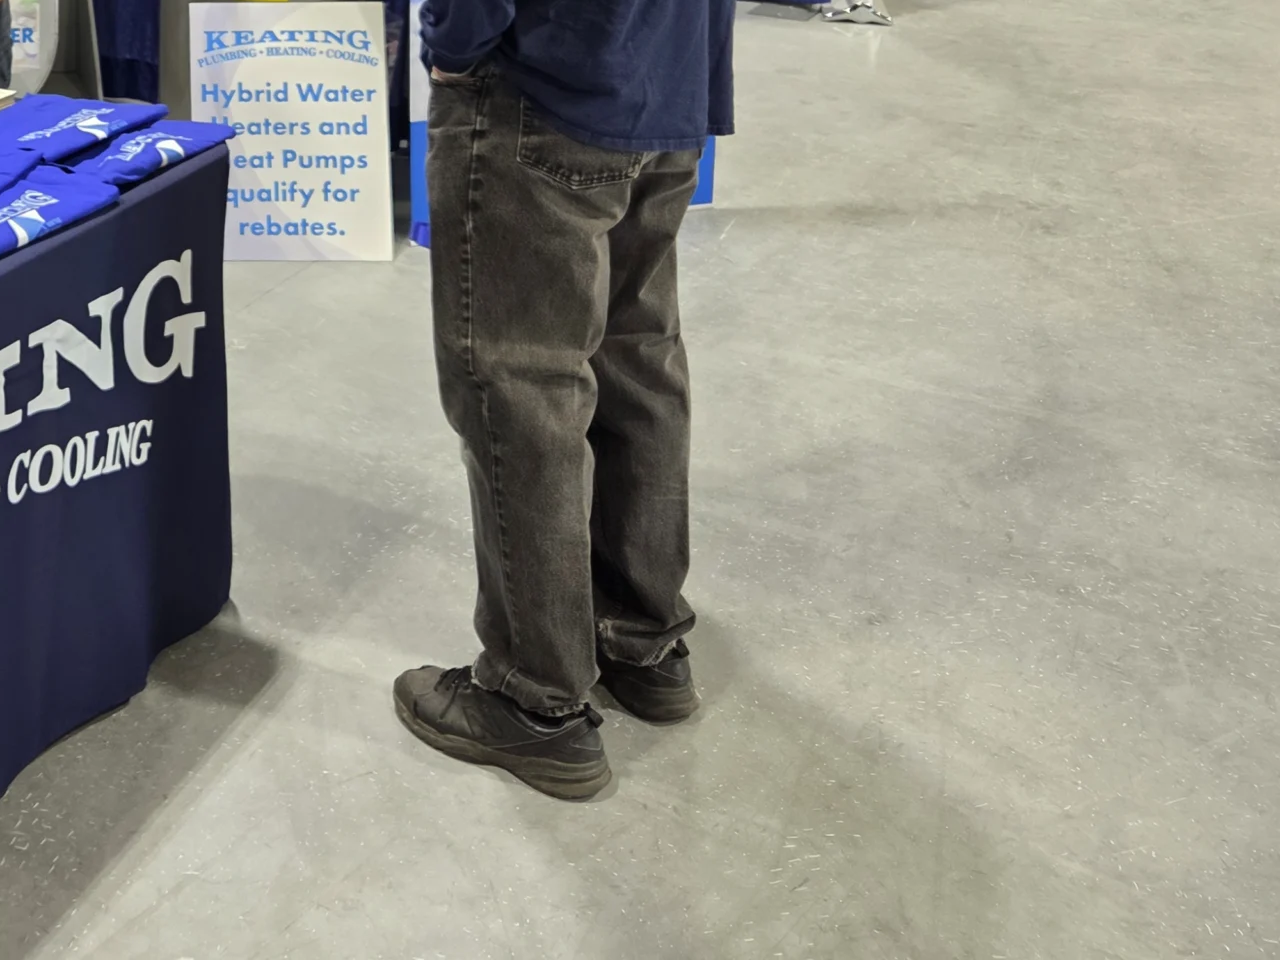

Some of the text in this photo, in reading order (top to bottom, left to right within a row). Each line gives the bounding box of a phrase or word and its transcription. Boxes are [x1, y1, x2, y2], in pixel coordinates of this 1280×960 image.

[203, 30, 371, 53] KEATING
[197, 46, 379, 68] PLUMBING HEATING COOLING
[201, 82, 377, 108] Hybrid Water
[319, 115, 368, 136] and
[233, 149, 368, 174] eat Pumps
[227, 181, 360, 208] qualify for
[239, 215, 346, 236] rebates.
[6, 419, 154, 504] COOLING
